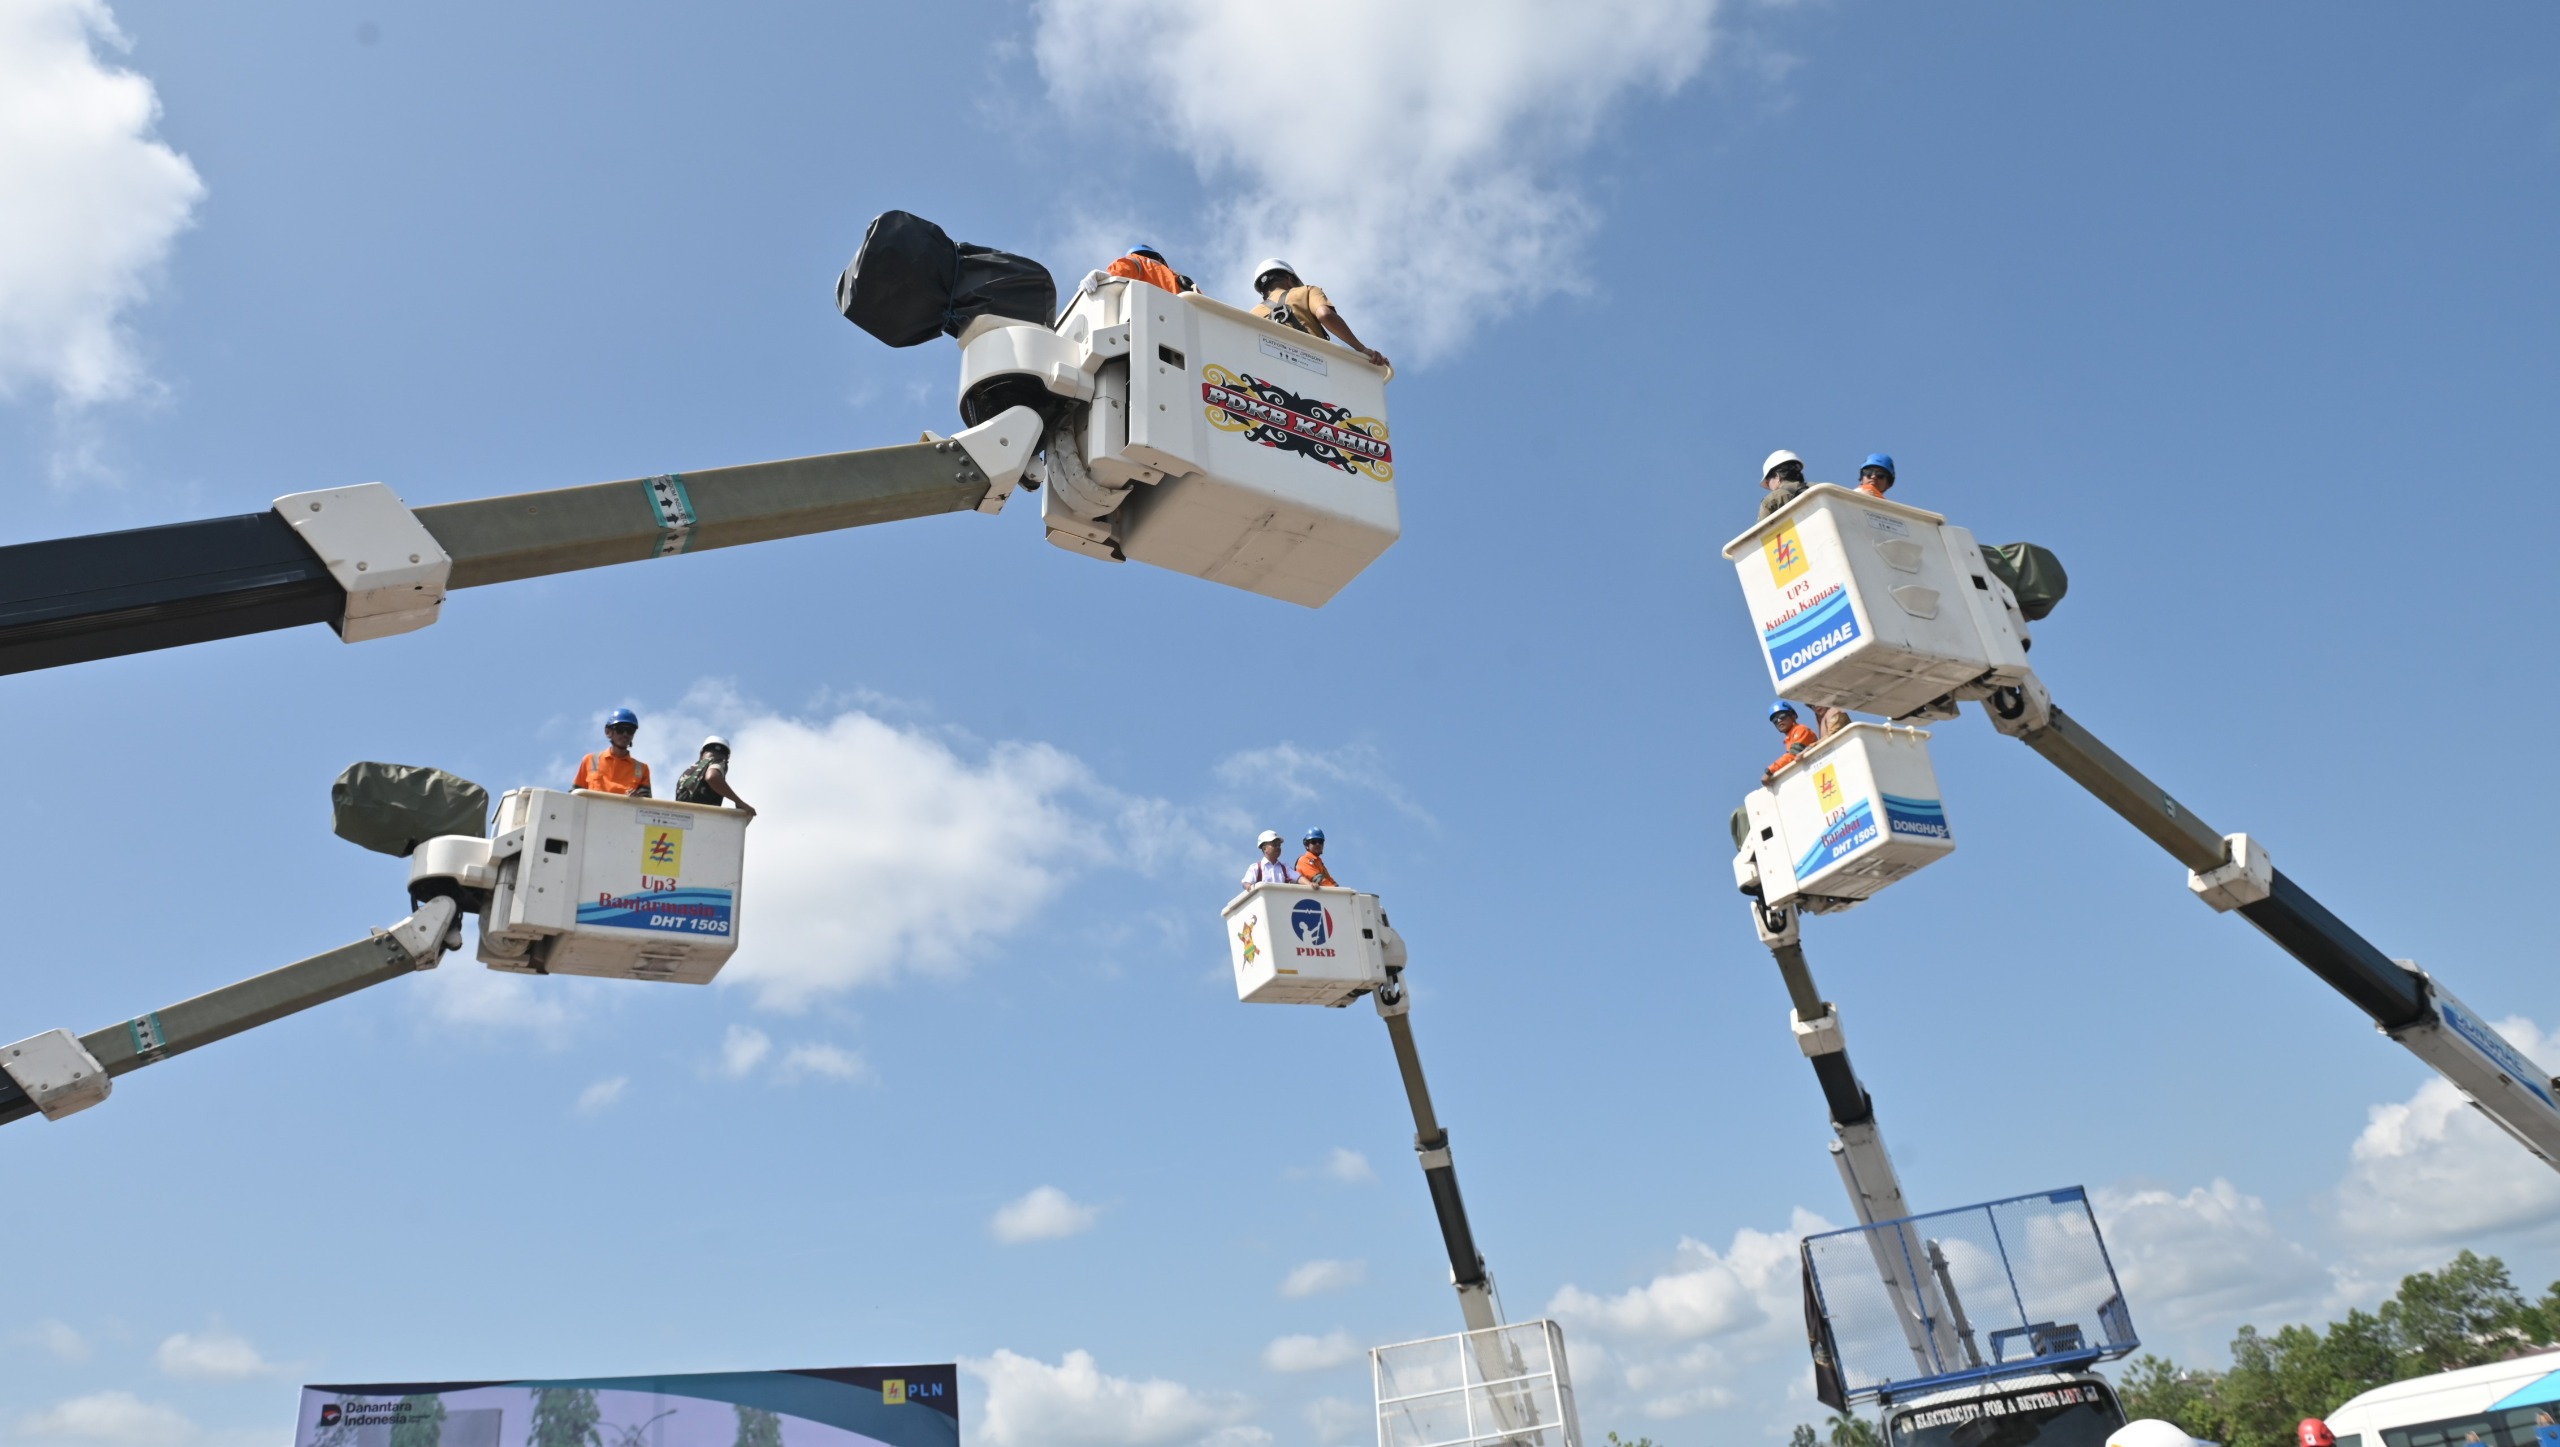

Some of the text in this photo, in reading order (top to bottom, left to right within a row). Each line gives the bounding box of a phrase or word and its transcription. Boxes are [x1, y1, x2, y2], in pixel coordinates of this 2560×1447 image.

[1207, 386, 1387, 459] PDKB KAHIU
[1787, 580, 1810, 600] UP3
[1766, 582, 1841, 632] Kuala Kapuas
[1780, 621, 1853, 675] DONGHAE
[1825, 806, 1847, 828] UP3
[1893, 819, 1945, 836] DONGHAE
[1820, 815, 1861, 848] Barabai
[1832, 824, 1877, 858] DHT 150S
[641, 875, 677, 893] Up3
[599, 892, 715, 917] Banjarmasin
[650, 915, 728, 932] DHT 150S
[1296, 947, 1336, 957] PDKB
[908, 1383, 943, 1397] PLN
[345, 1402, 412, 1413] Danantara
[1914, 1403, 1980, 1430] ELECTRICITY
[1982, 1399, 2005, 1417] FOR
[2007, 1398, 2017, 1414] A
[344, 1413, 407, 1426] Indonesia
